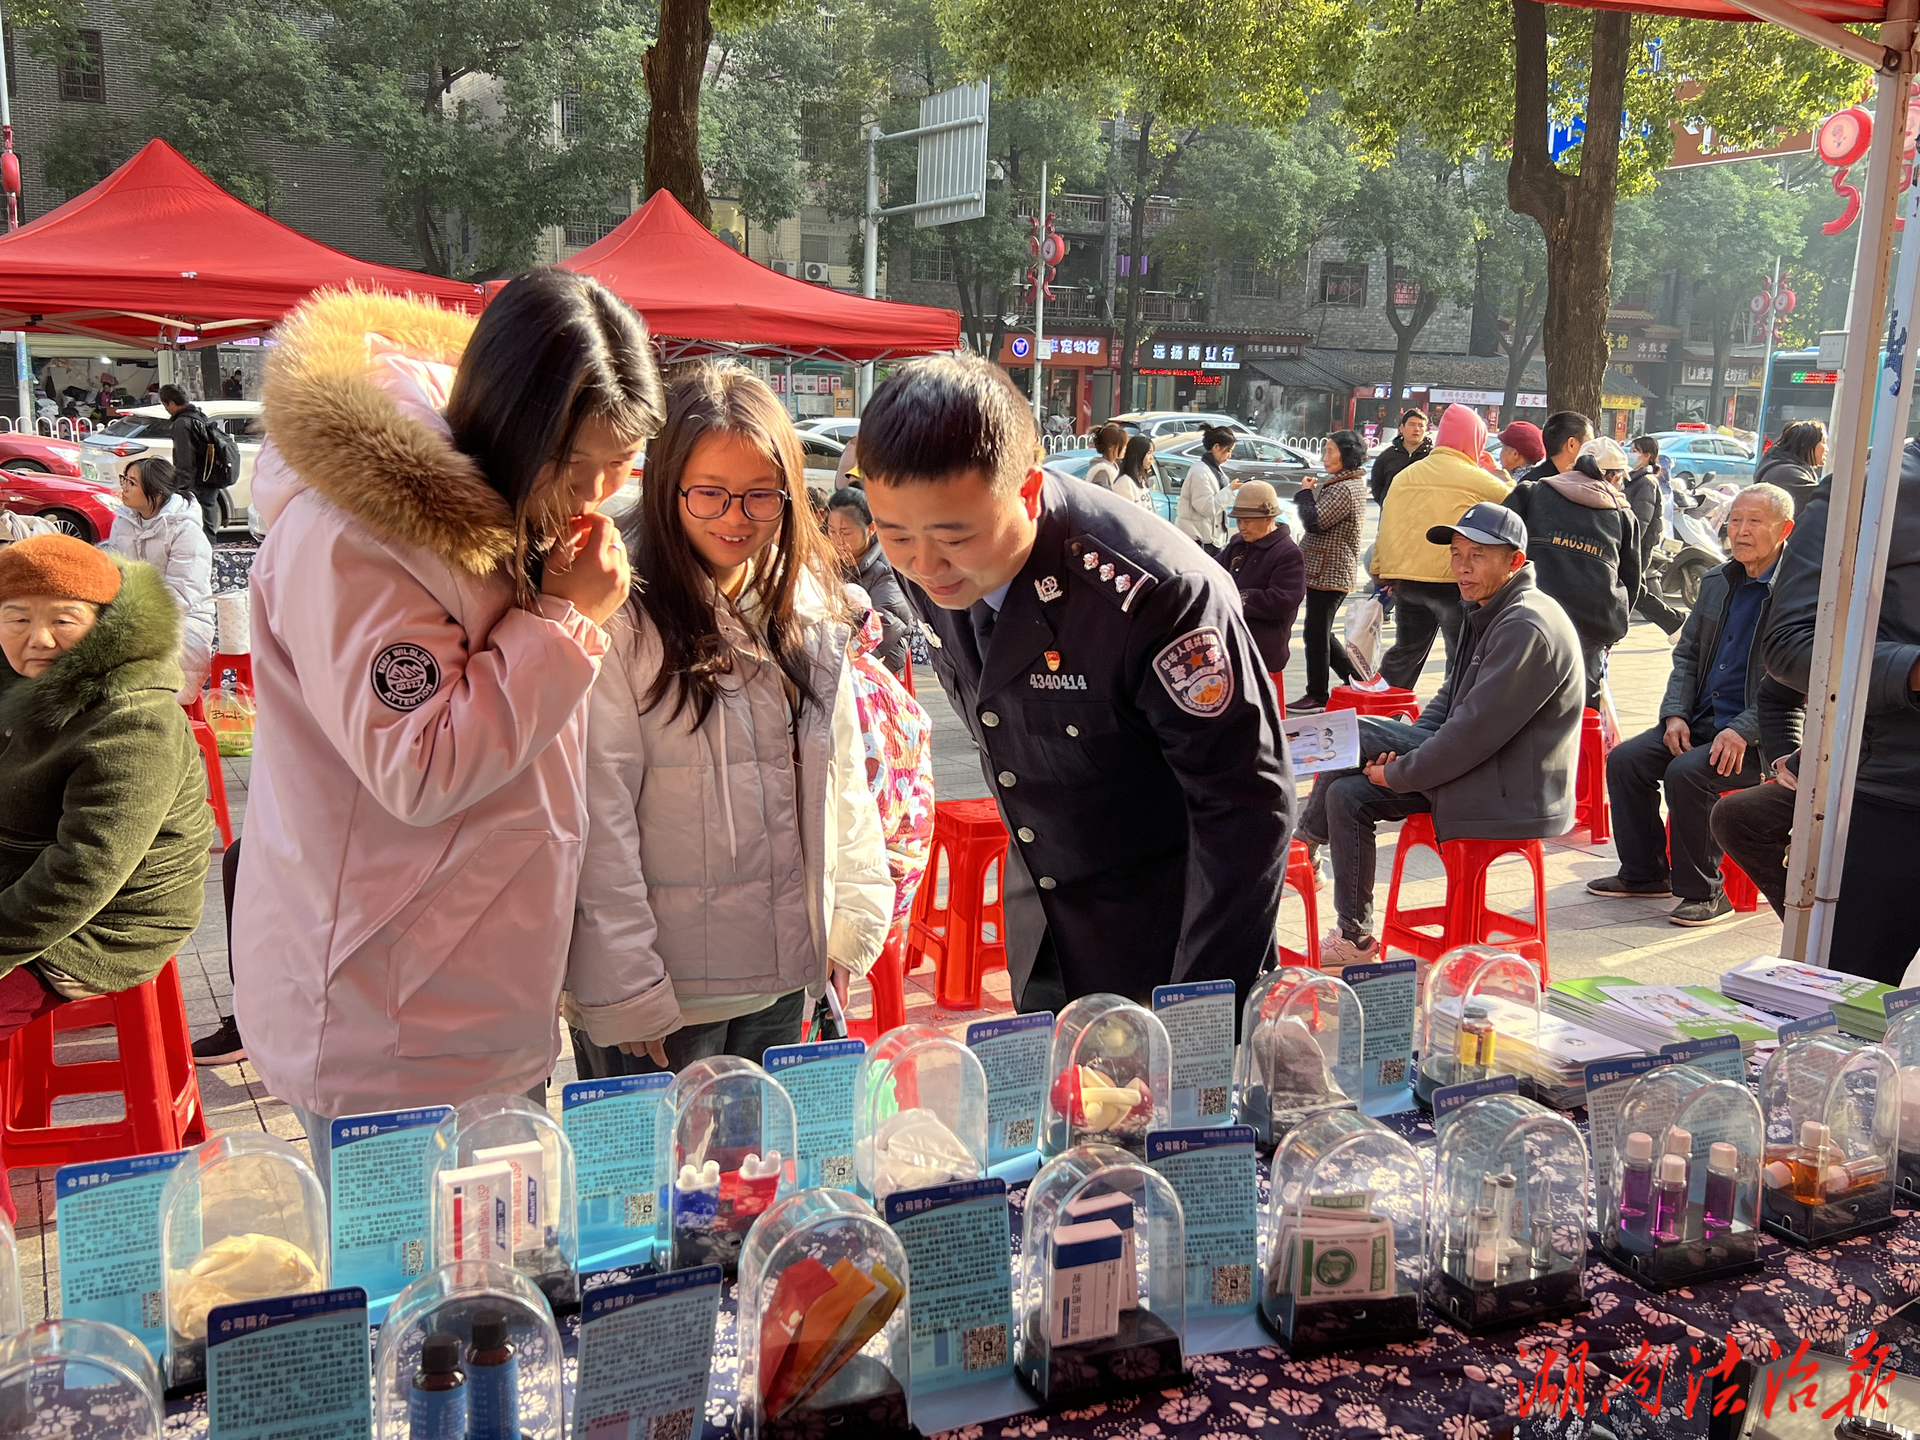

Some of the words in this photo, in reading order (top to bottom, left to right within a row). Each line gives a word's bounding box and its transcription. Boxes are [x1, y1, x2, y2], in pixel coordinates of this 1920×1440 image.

[1160, 634, 1219, 670] 中华人民共和国
[377, 654, 392, 674] KEEP
[392, 648, 431, 667] WILDLIFE
[1030, 673, 1088, 690] 4340414
[384, 682, 434, 706] ATTENTION
[772, 1054, 804, 1066] 公司简介
[569, 1087, 603, 1099] 公司简介
[340, 1124, 378, 1138] 公司简介
[1155, 1140, 1189, 1152] 公司简介
[67, 1172, 113, 1188] 公司简介
[477, 1184, 489, 1202] USP
[894, 1198, 933, 1212] 公司简介
[478, 1202, 490, 1232] Tablets
[592, 1293, 636, 1312] 公司简介
[220, 1313, 270, 1332] 公司简介
